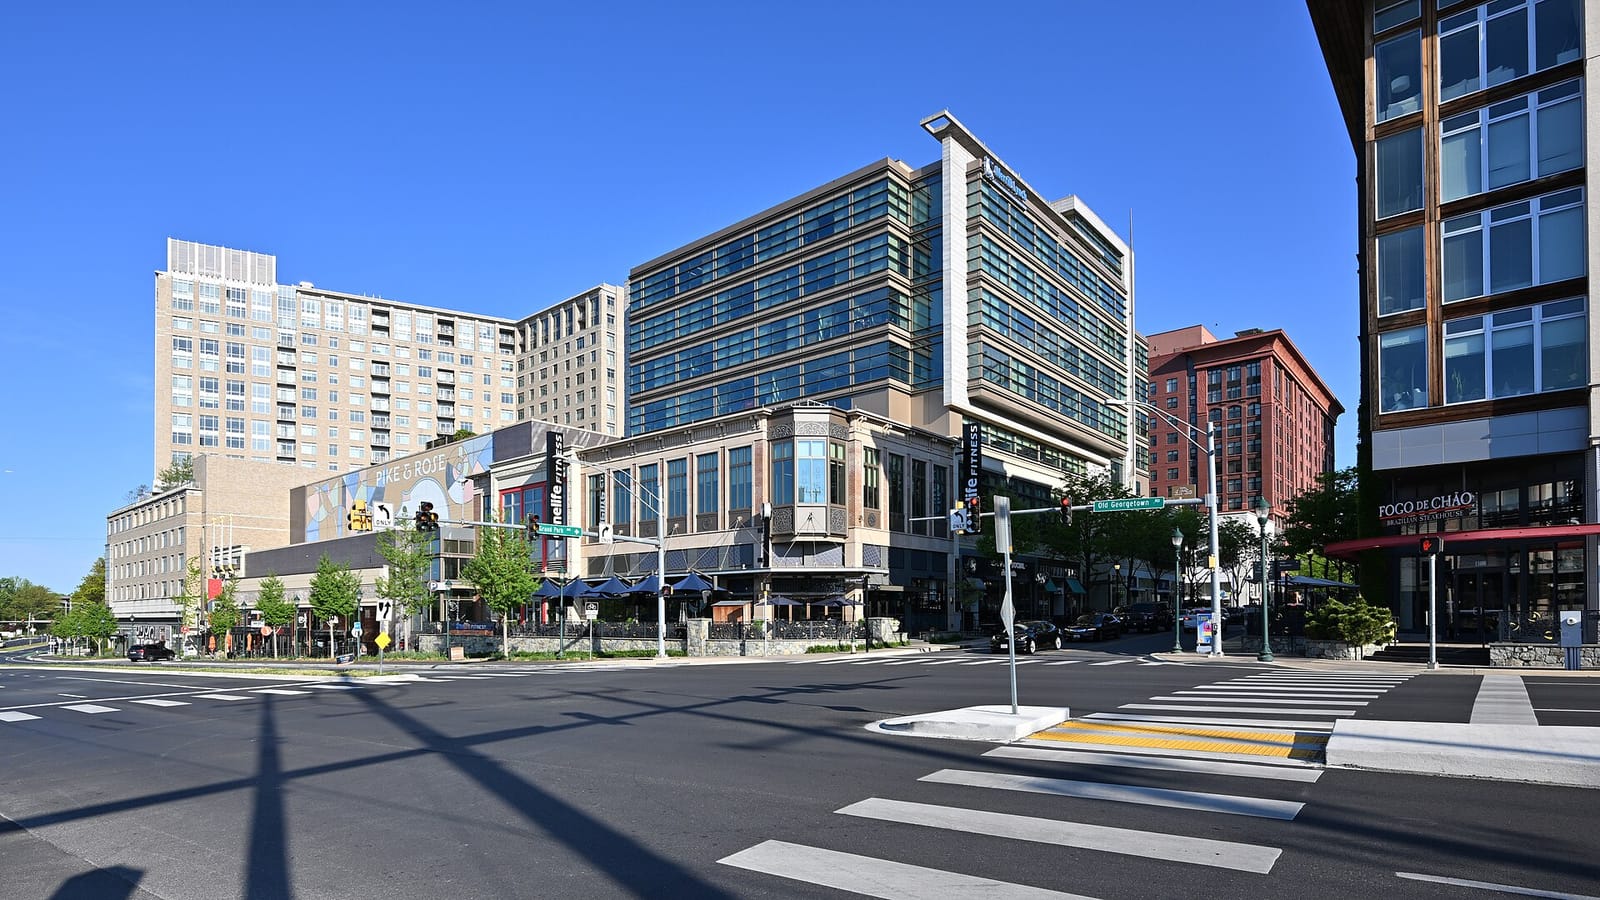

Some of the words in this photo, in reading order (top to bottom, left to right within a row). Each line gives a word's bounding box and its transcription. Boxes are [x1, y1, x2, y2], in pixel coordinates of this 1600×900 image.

[970, 425, 978, 476] FITNESS
[376, 466, 401, 488] PIKE
[403, 463, 412, 480] &
[415, 454, 447, 477] ROSE
[1110, 500, 1150, 509] Georgetown
[1379, 501, 1414, 517] FOGO
[1416, 500, 1430, 511] DE
[1431, 491, 1472, 510] CHÃO
[1419, 510, 1464, 522] STEAKHOUSE
